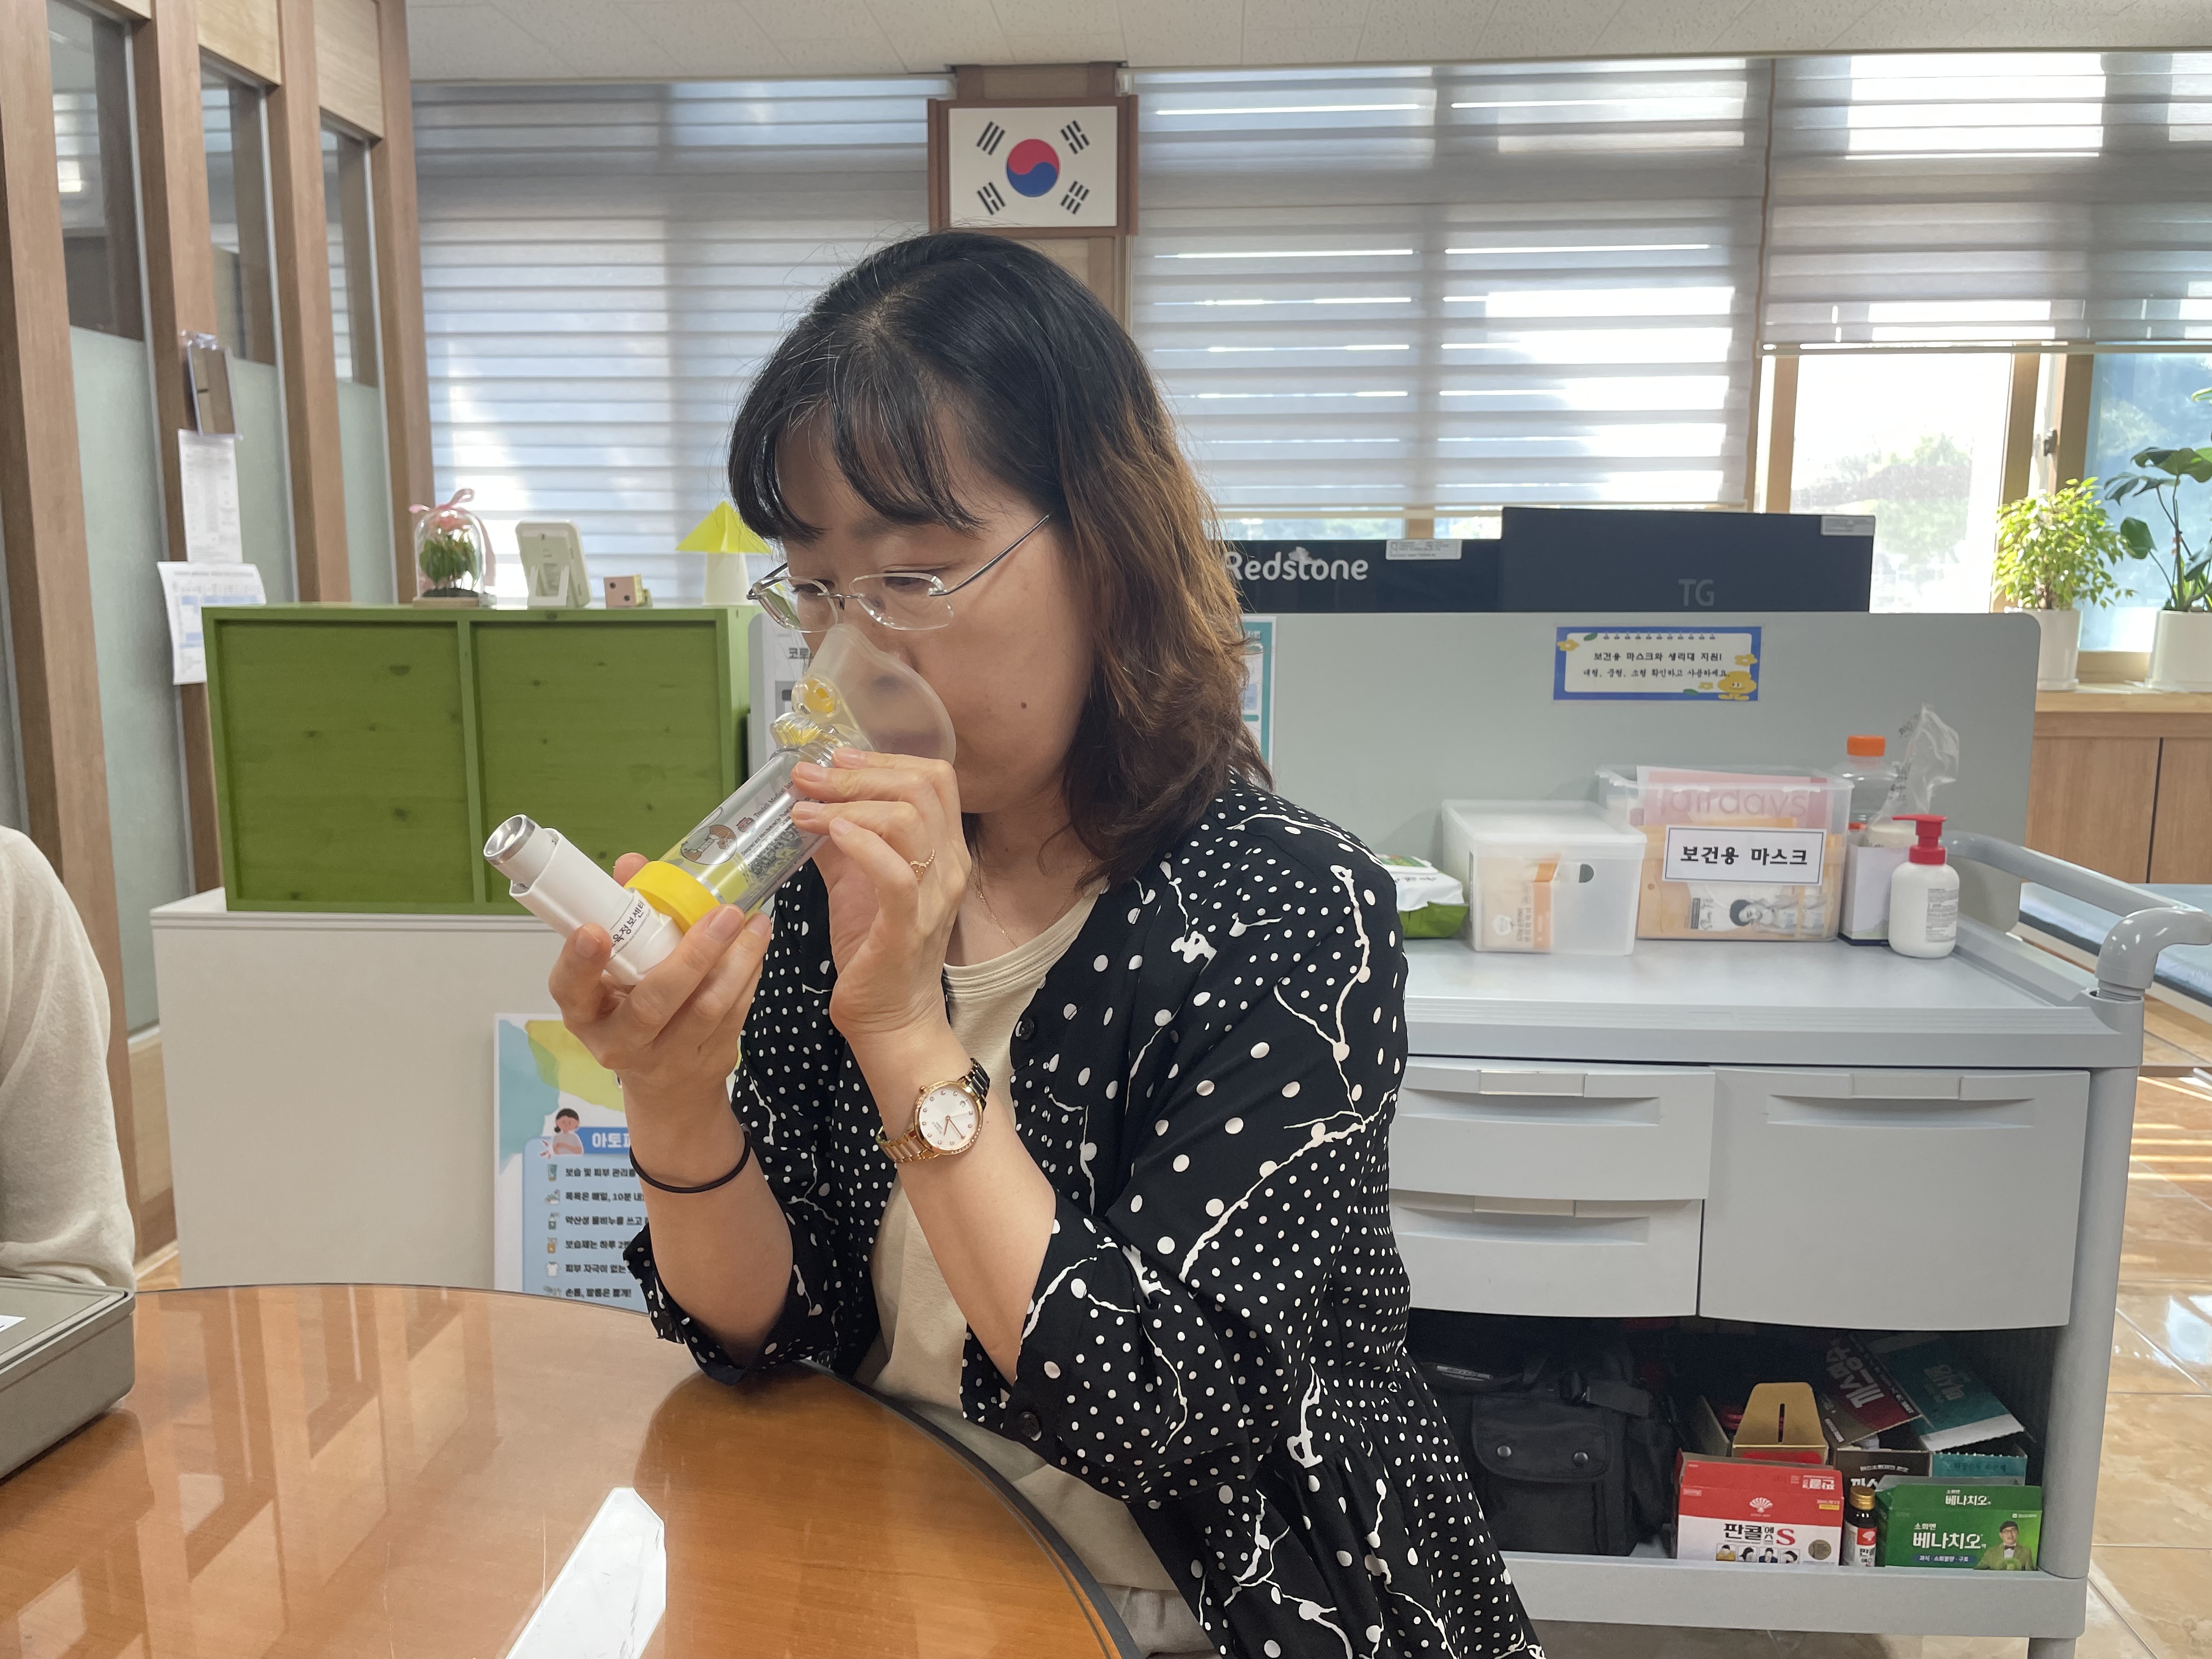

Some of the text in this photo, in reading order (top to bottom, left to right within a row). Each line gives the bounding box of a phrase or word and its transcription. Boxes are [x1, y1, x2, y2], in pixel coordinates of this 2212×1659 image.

[1226, 550, 1369, 581] Redstone
[1678, 578, 1714, 606] TG
[788, 647, 810, 659] 코로
[1594, 652, 1722, 662] 보건용 마스크와 생리대 지원!
[1583, 668, 1602, 678] 대형,
[1630, 668, 1646, 678] 소형
[1651, 668, 1683, 678] 확인하고
[754, 803, 770, 818] Trudell
[770, 788, 786, 803] Medical
[1680, 846, 1807, 866] 보건용 마스크
[612, 899, 645, 947] 육정보센터
[594, 1168, 610, 1177] 피부
[627, 1216, 642, 1226] 쓰고
[600, 1240, 616, 1249] 하루
[566, 1264, 581, 1273] 피부
[583, 1264, 608, 1273] 자극이
[1945, 1495, 1988, 1505] 베나치오
[1912, 1532, 1982, 1550] 베나치오
